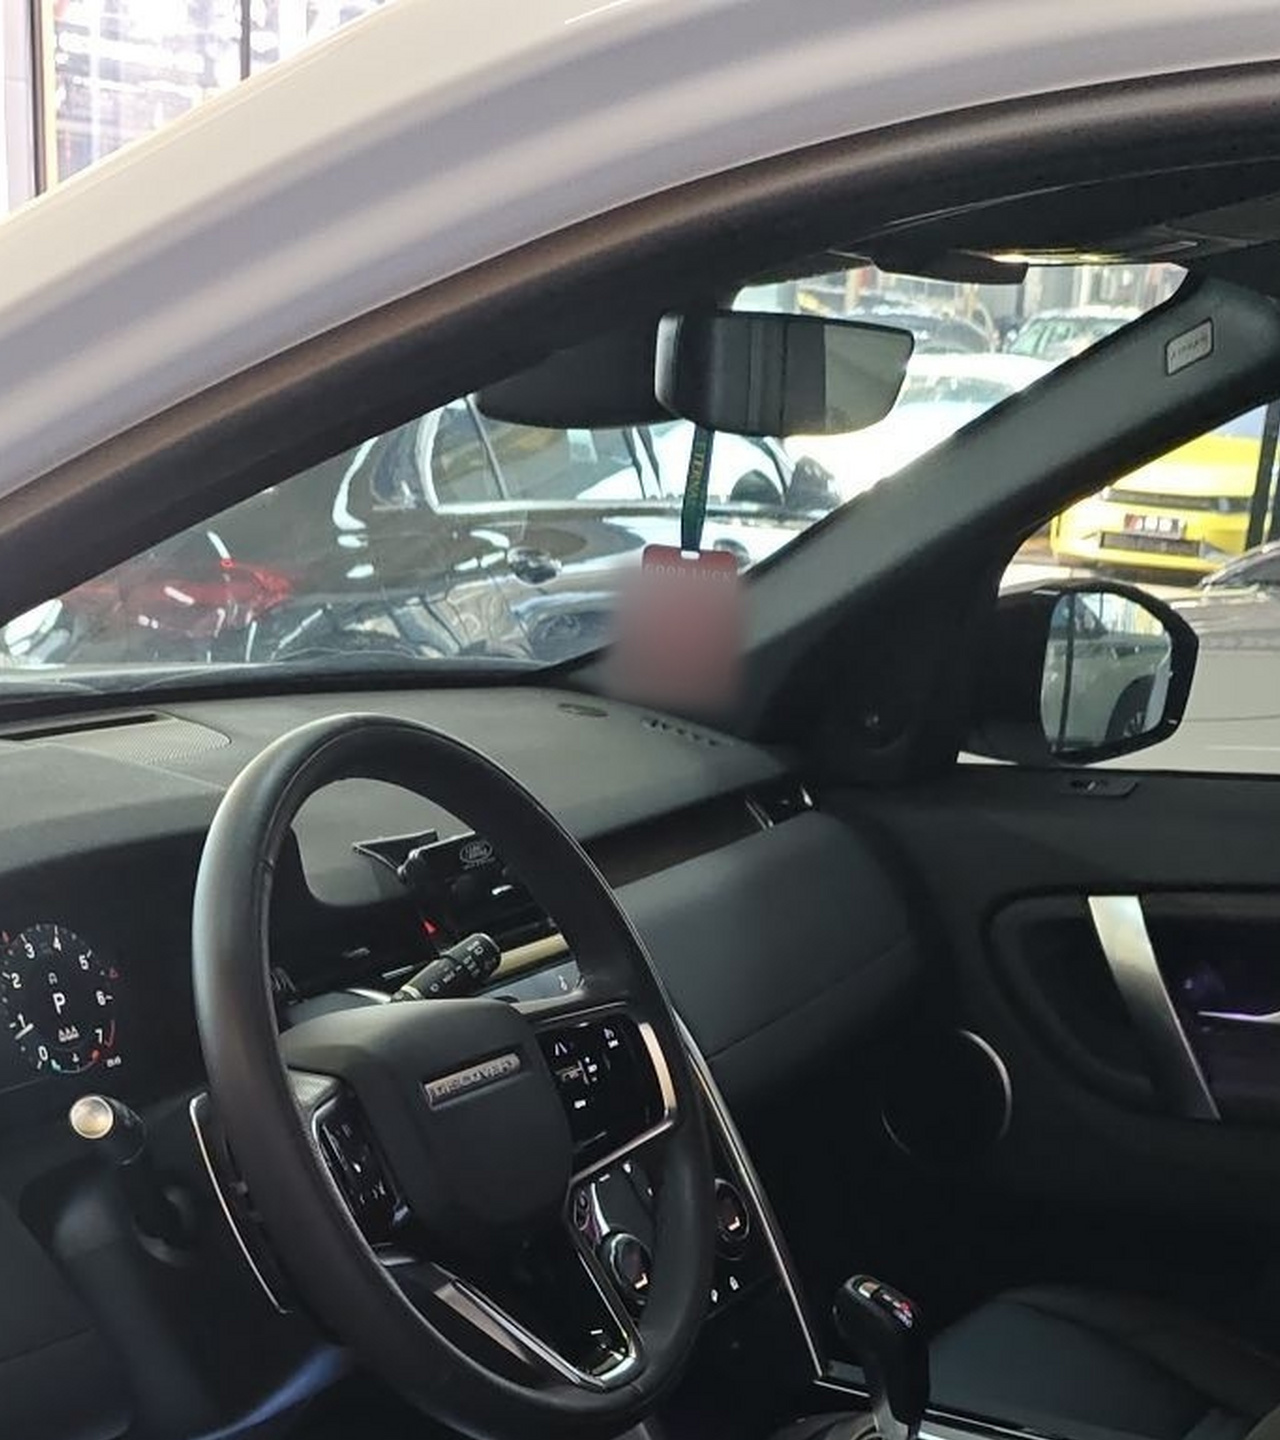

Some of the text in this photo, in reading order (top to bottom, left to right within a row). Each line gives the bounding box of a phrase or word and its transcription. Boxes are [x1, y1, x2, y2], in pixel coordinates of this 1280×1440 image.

[644, 562, 732, 584] GOOD LUCK
[24, 942, 35, 959] 3
[52, 934, 62, 951] 4
[78, 954, 89, 970] 5
[10, 972, 22, 989] 2
[52, 992, 66, 1015] P
[95, 989, 107, 1006] 6
[95, 1028, 104, 1044] 7
[37, 1045, 49, 1061] 0
